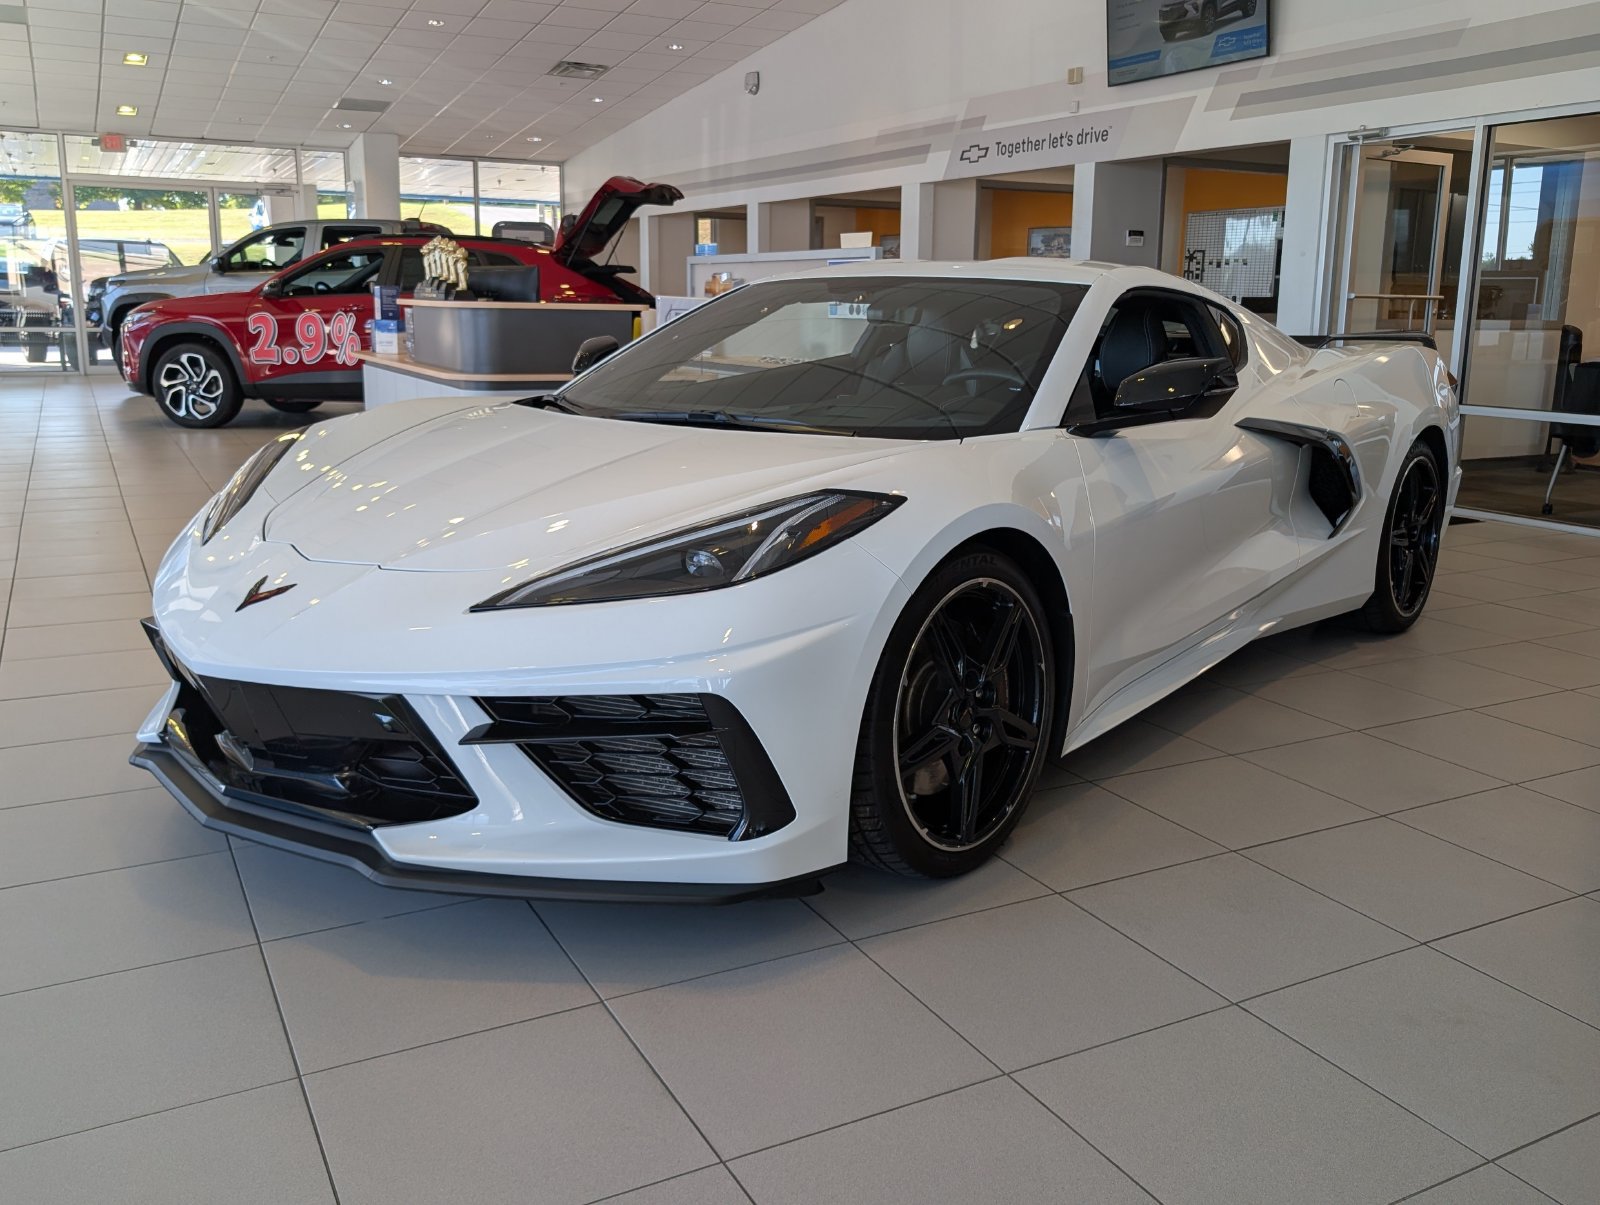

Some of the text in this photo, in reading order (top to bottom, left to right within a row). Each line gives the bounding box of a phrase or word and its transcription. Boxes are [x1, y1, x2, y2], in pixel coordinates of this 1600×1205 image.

[995, 137, 1046, 158] Together
[1048, 132, 1073, 149] let's
[248, 311, 361, 366] 2.9%
